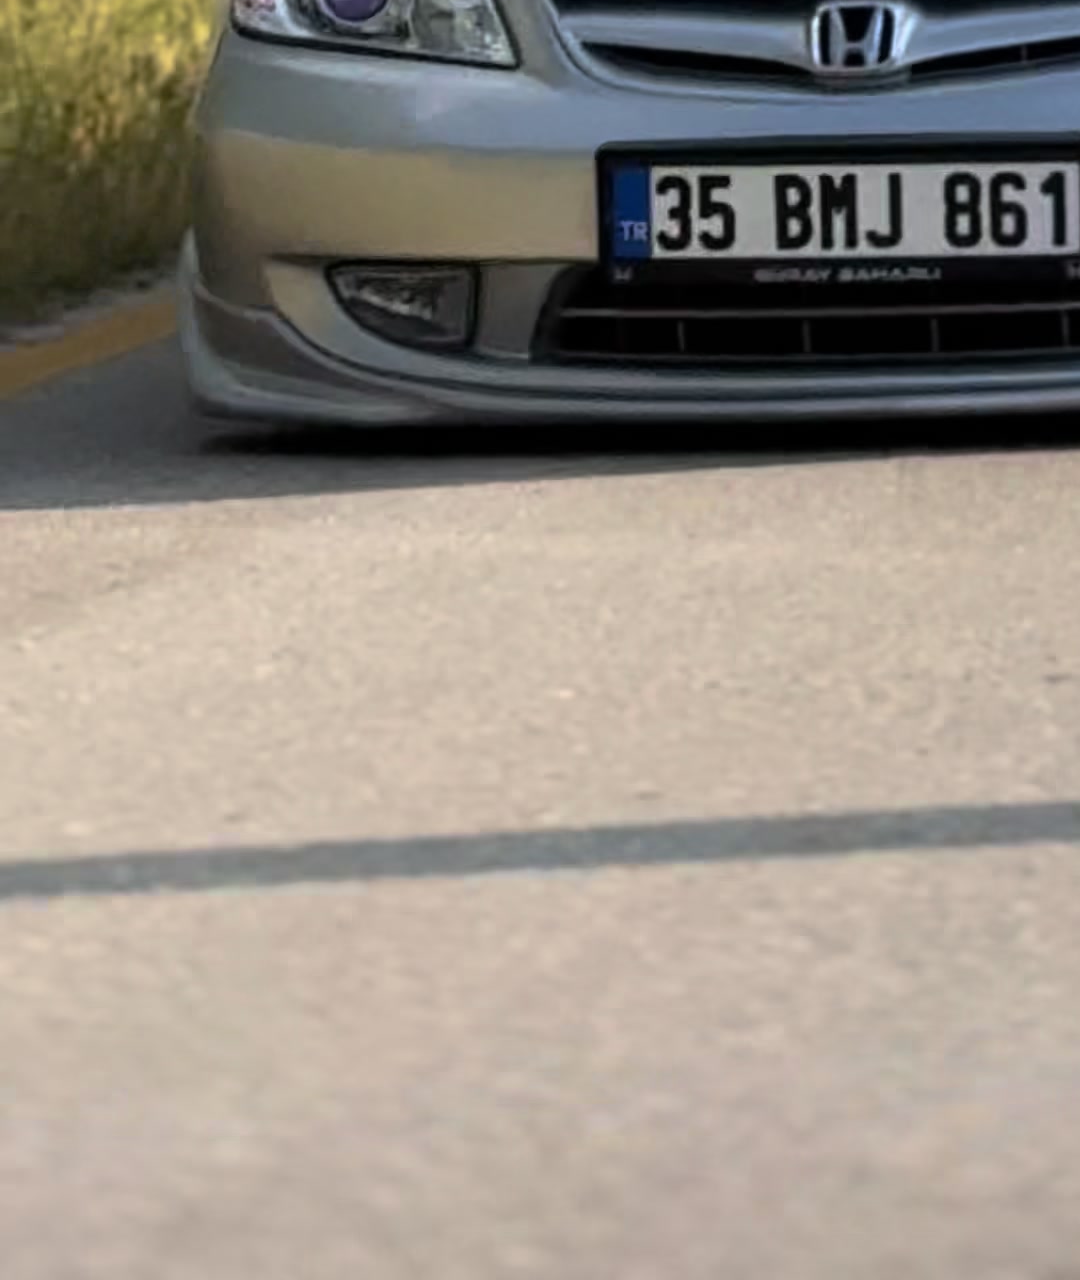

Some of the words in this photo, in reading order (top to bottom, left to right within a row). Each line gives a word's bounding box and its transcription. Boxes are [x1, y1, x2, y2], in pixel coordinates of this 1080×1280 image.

[620, 220, 649, 242] TR
[655, 174, 736, 252] 35
[774, 171, 903, 251] BMJ
[942, 170, 1069, 248] 861
